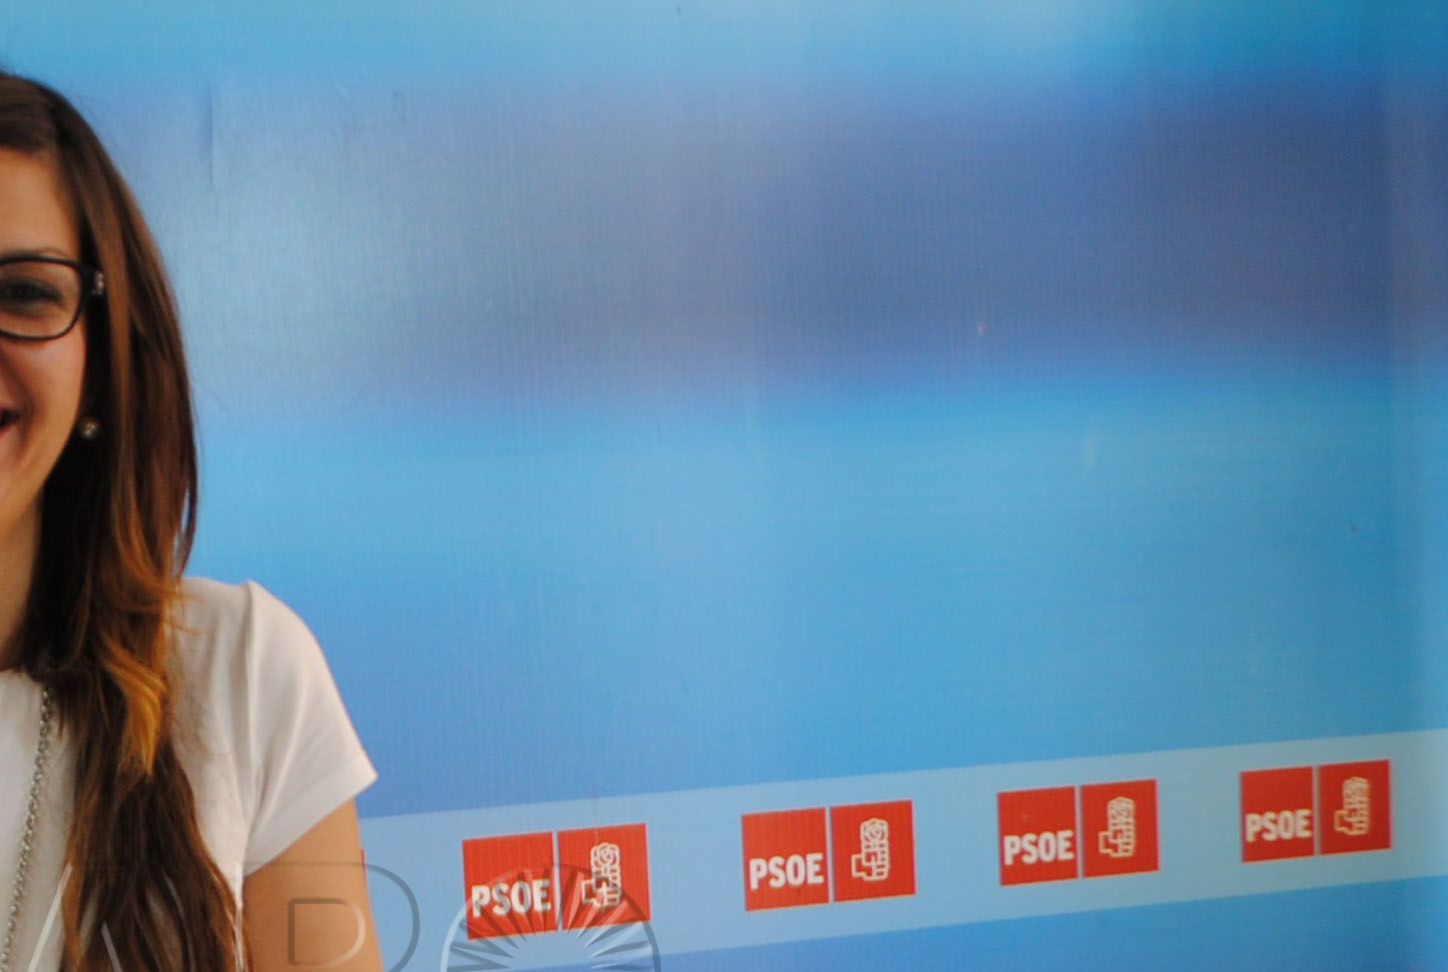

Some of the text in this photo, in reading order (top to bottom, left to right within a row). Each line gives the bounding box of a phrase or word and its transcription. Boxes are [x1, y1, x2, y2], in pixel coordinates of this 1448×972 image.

[1244, 808, 1312, 843] PSOE
[1002, 830, 1075, 866] PSOE
[748, 853, 824, 891] PSOE
[471, 878, 552, 919] PSOE
